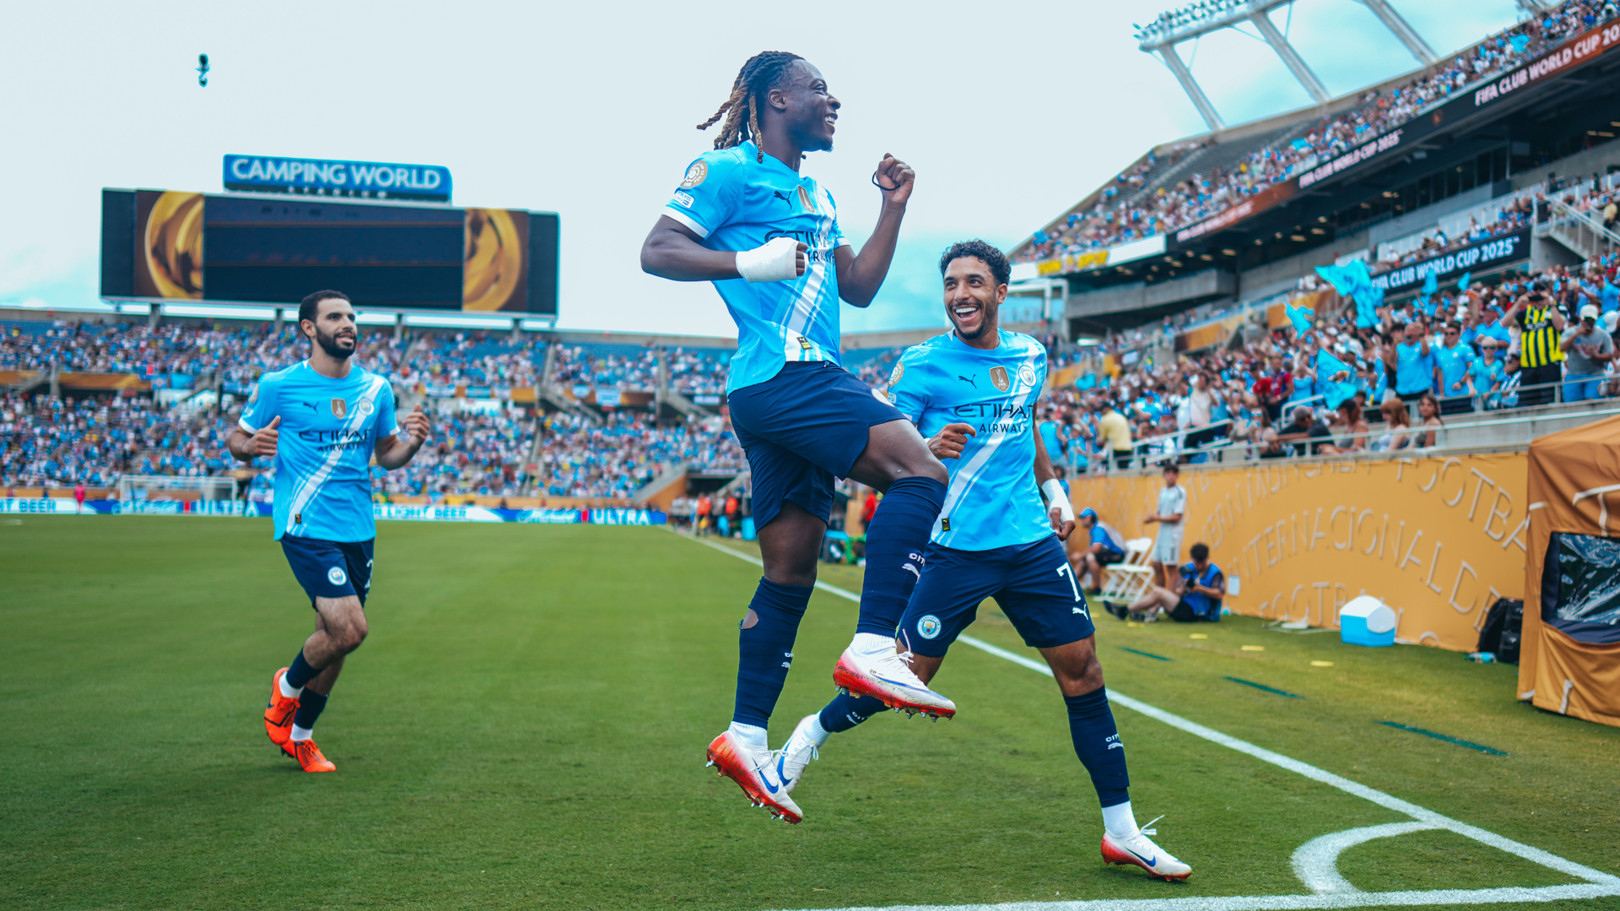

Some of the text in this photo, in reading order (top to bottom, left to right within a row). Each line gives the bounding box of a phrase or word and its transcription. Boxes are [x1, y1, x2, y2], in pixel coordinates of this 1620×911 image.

[1475, 23, 1620, 106] FIFA CLUB WORLD CUP 20
[232, 159, 441, 189] CAMPING WORLD
[1390, 267, 1415, 287] CLUB
[1456, 248, 1480, 269] CUP
[592, 508, 651, 526] ULTRA
[1056, 562, 1081, 603] 7
